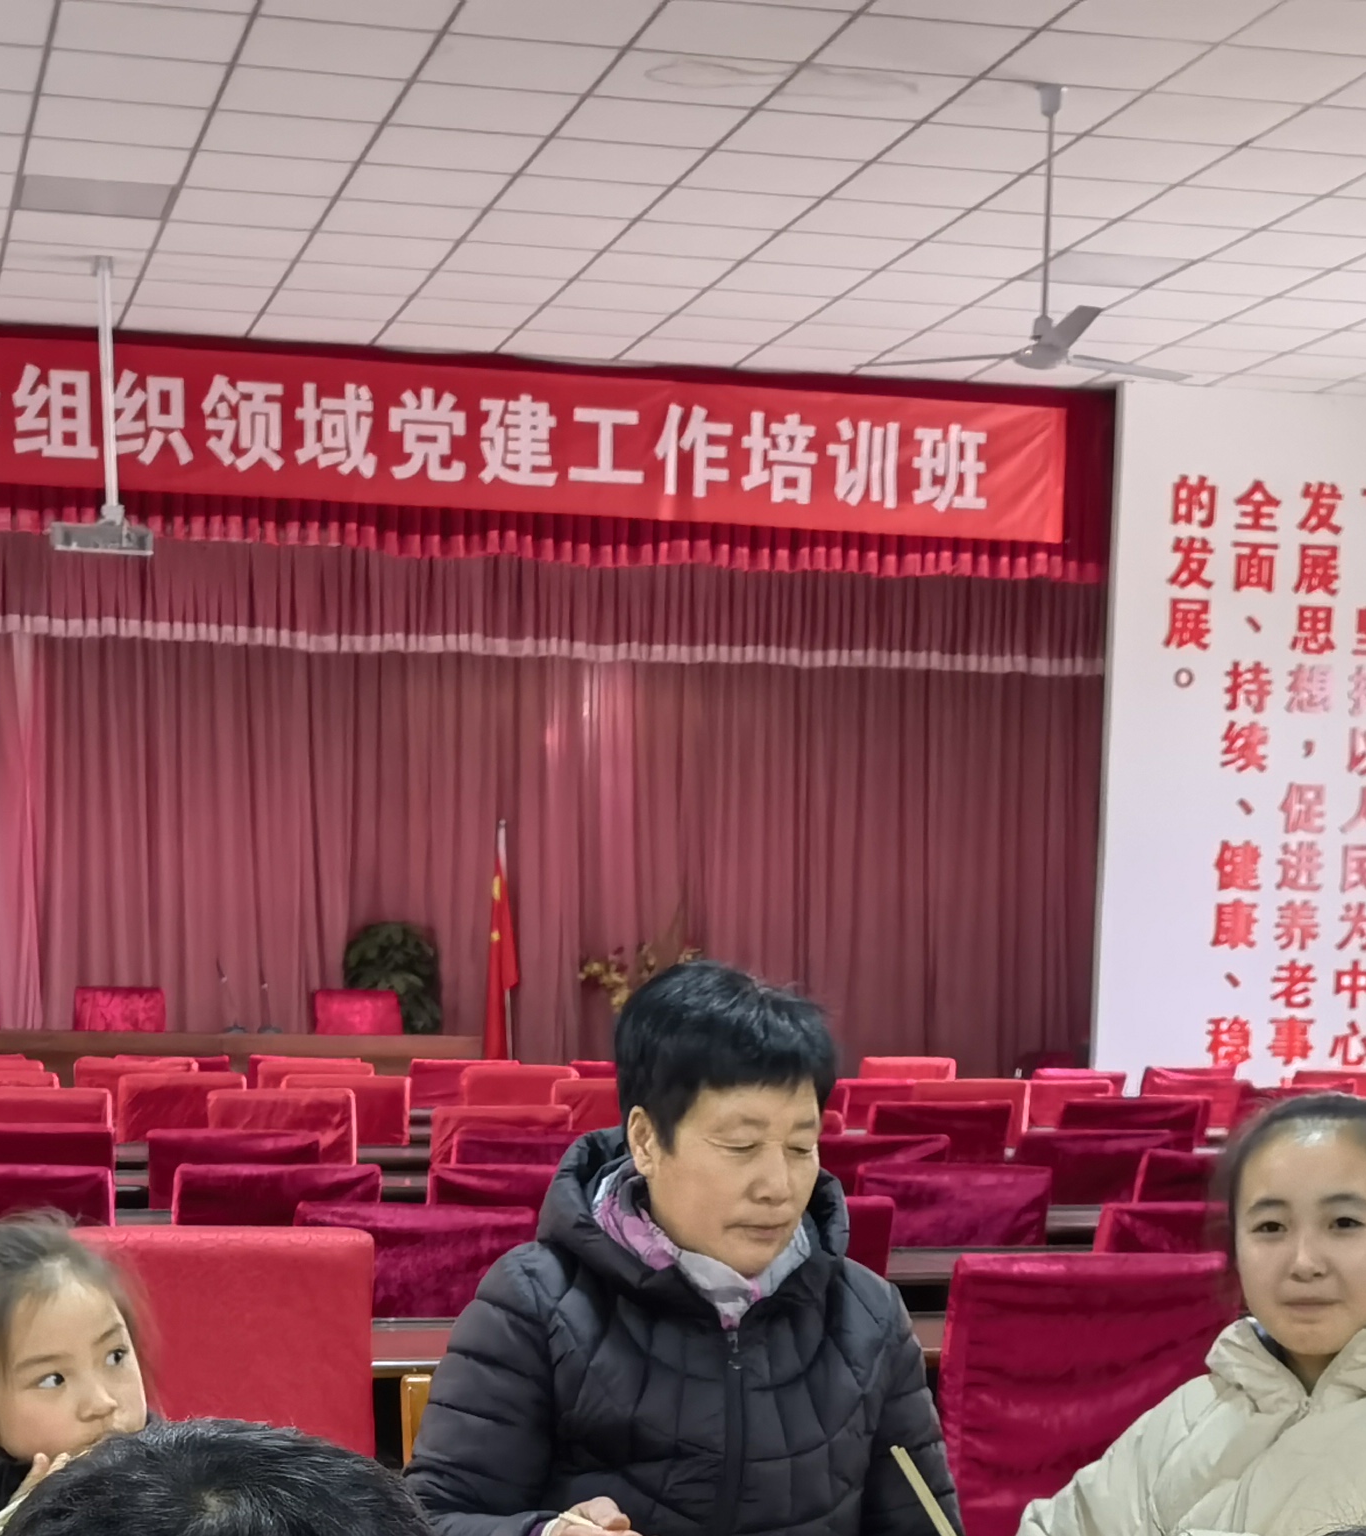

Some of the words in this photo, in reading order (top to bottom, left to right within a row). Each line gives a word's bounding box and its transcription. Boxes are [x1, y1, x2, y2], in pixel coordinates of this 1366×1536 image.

[1162, 474, 1217, 688] 的发展。
[1206, 479, 1283, 1068] 全面、持续、健康、稳
[1266, 481, 1345, 1087] 发展思想，促进养老事
